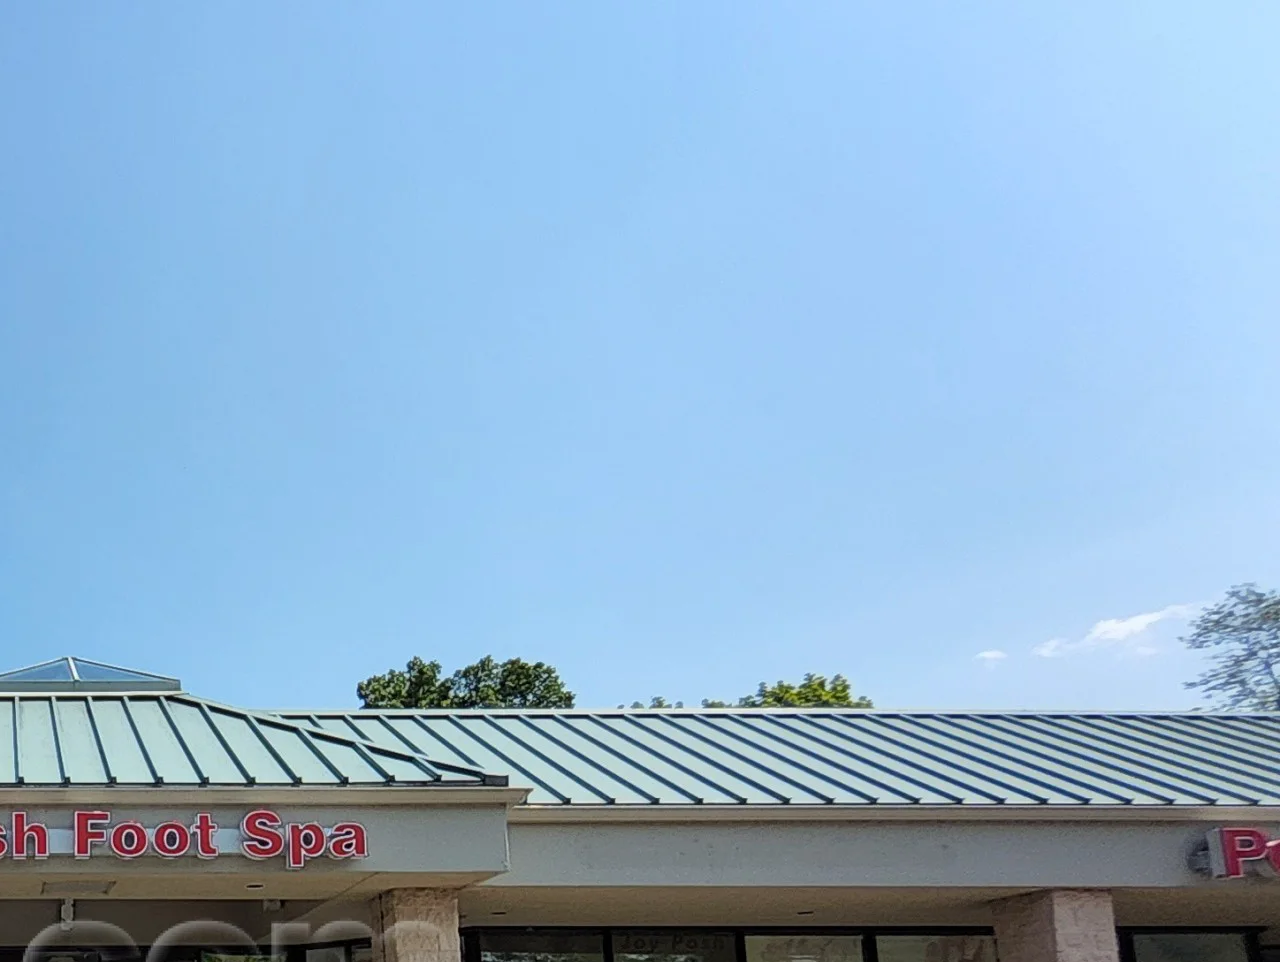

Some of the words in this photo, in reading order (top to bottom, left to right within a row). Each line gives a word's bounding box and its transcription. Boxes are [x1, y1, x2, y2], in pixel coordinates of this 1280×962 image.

[73, 810, 218, 860] Foot
[241, 809, 369, 869] Spa
[1218, 827, 1280, 880] P
